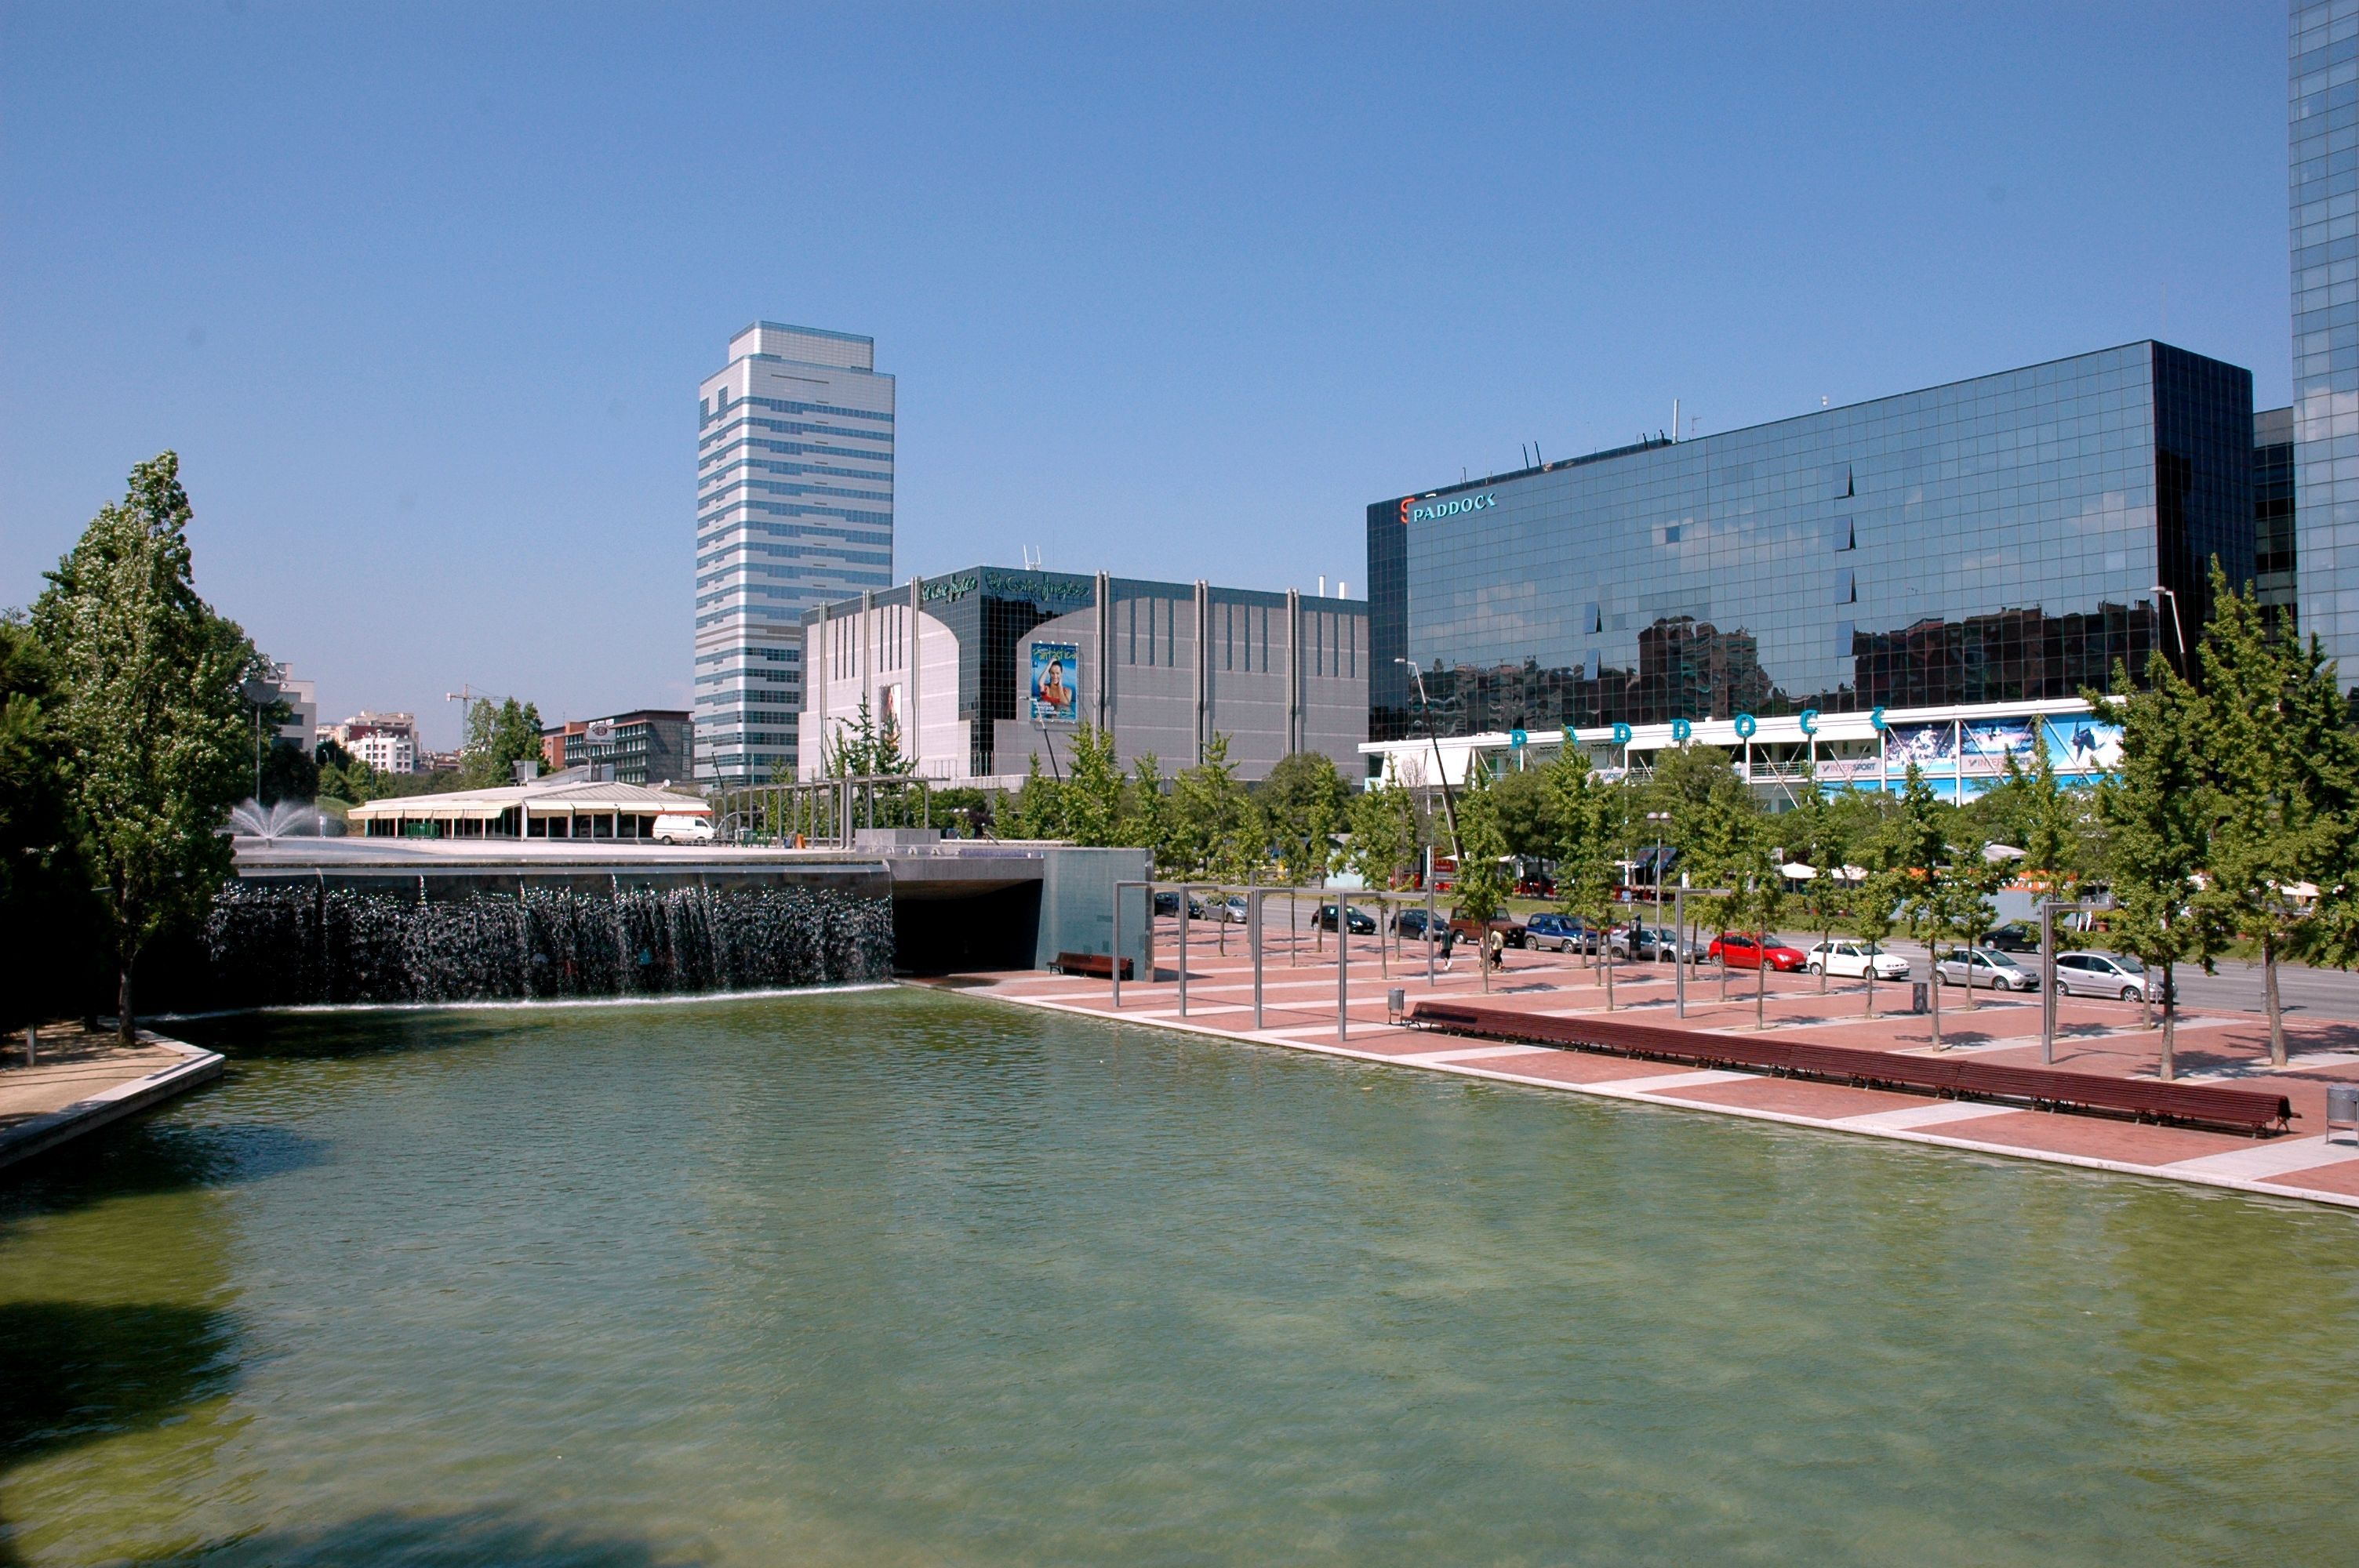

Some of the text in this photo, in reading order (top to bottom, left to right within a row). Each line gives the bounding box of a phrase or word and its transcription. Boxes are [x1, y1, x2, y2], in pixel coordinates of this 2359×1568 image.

[1413, 492, 1497, 522] PADDOCK
[1004, 574, 1037, 592] Corte
[1830, 762, 1877, 772] INTERSPORT
